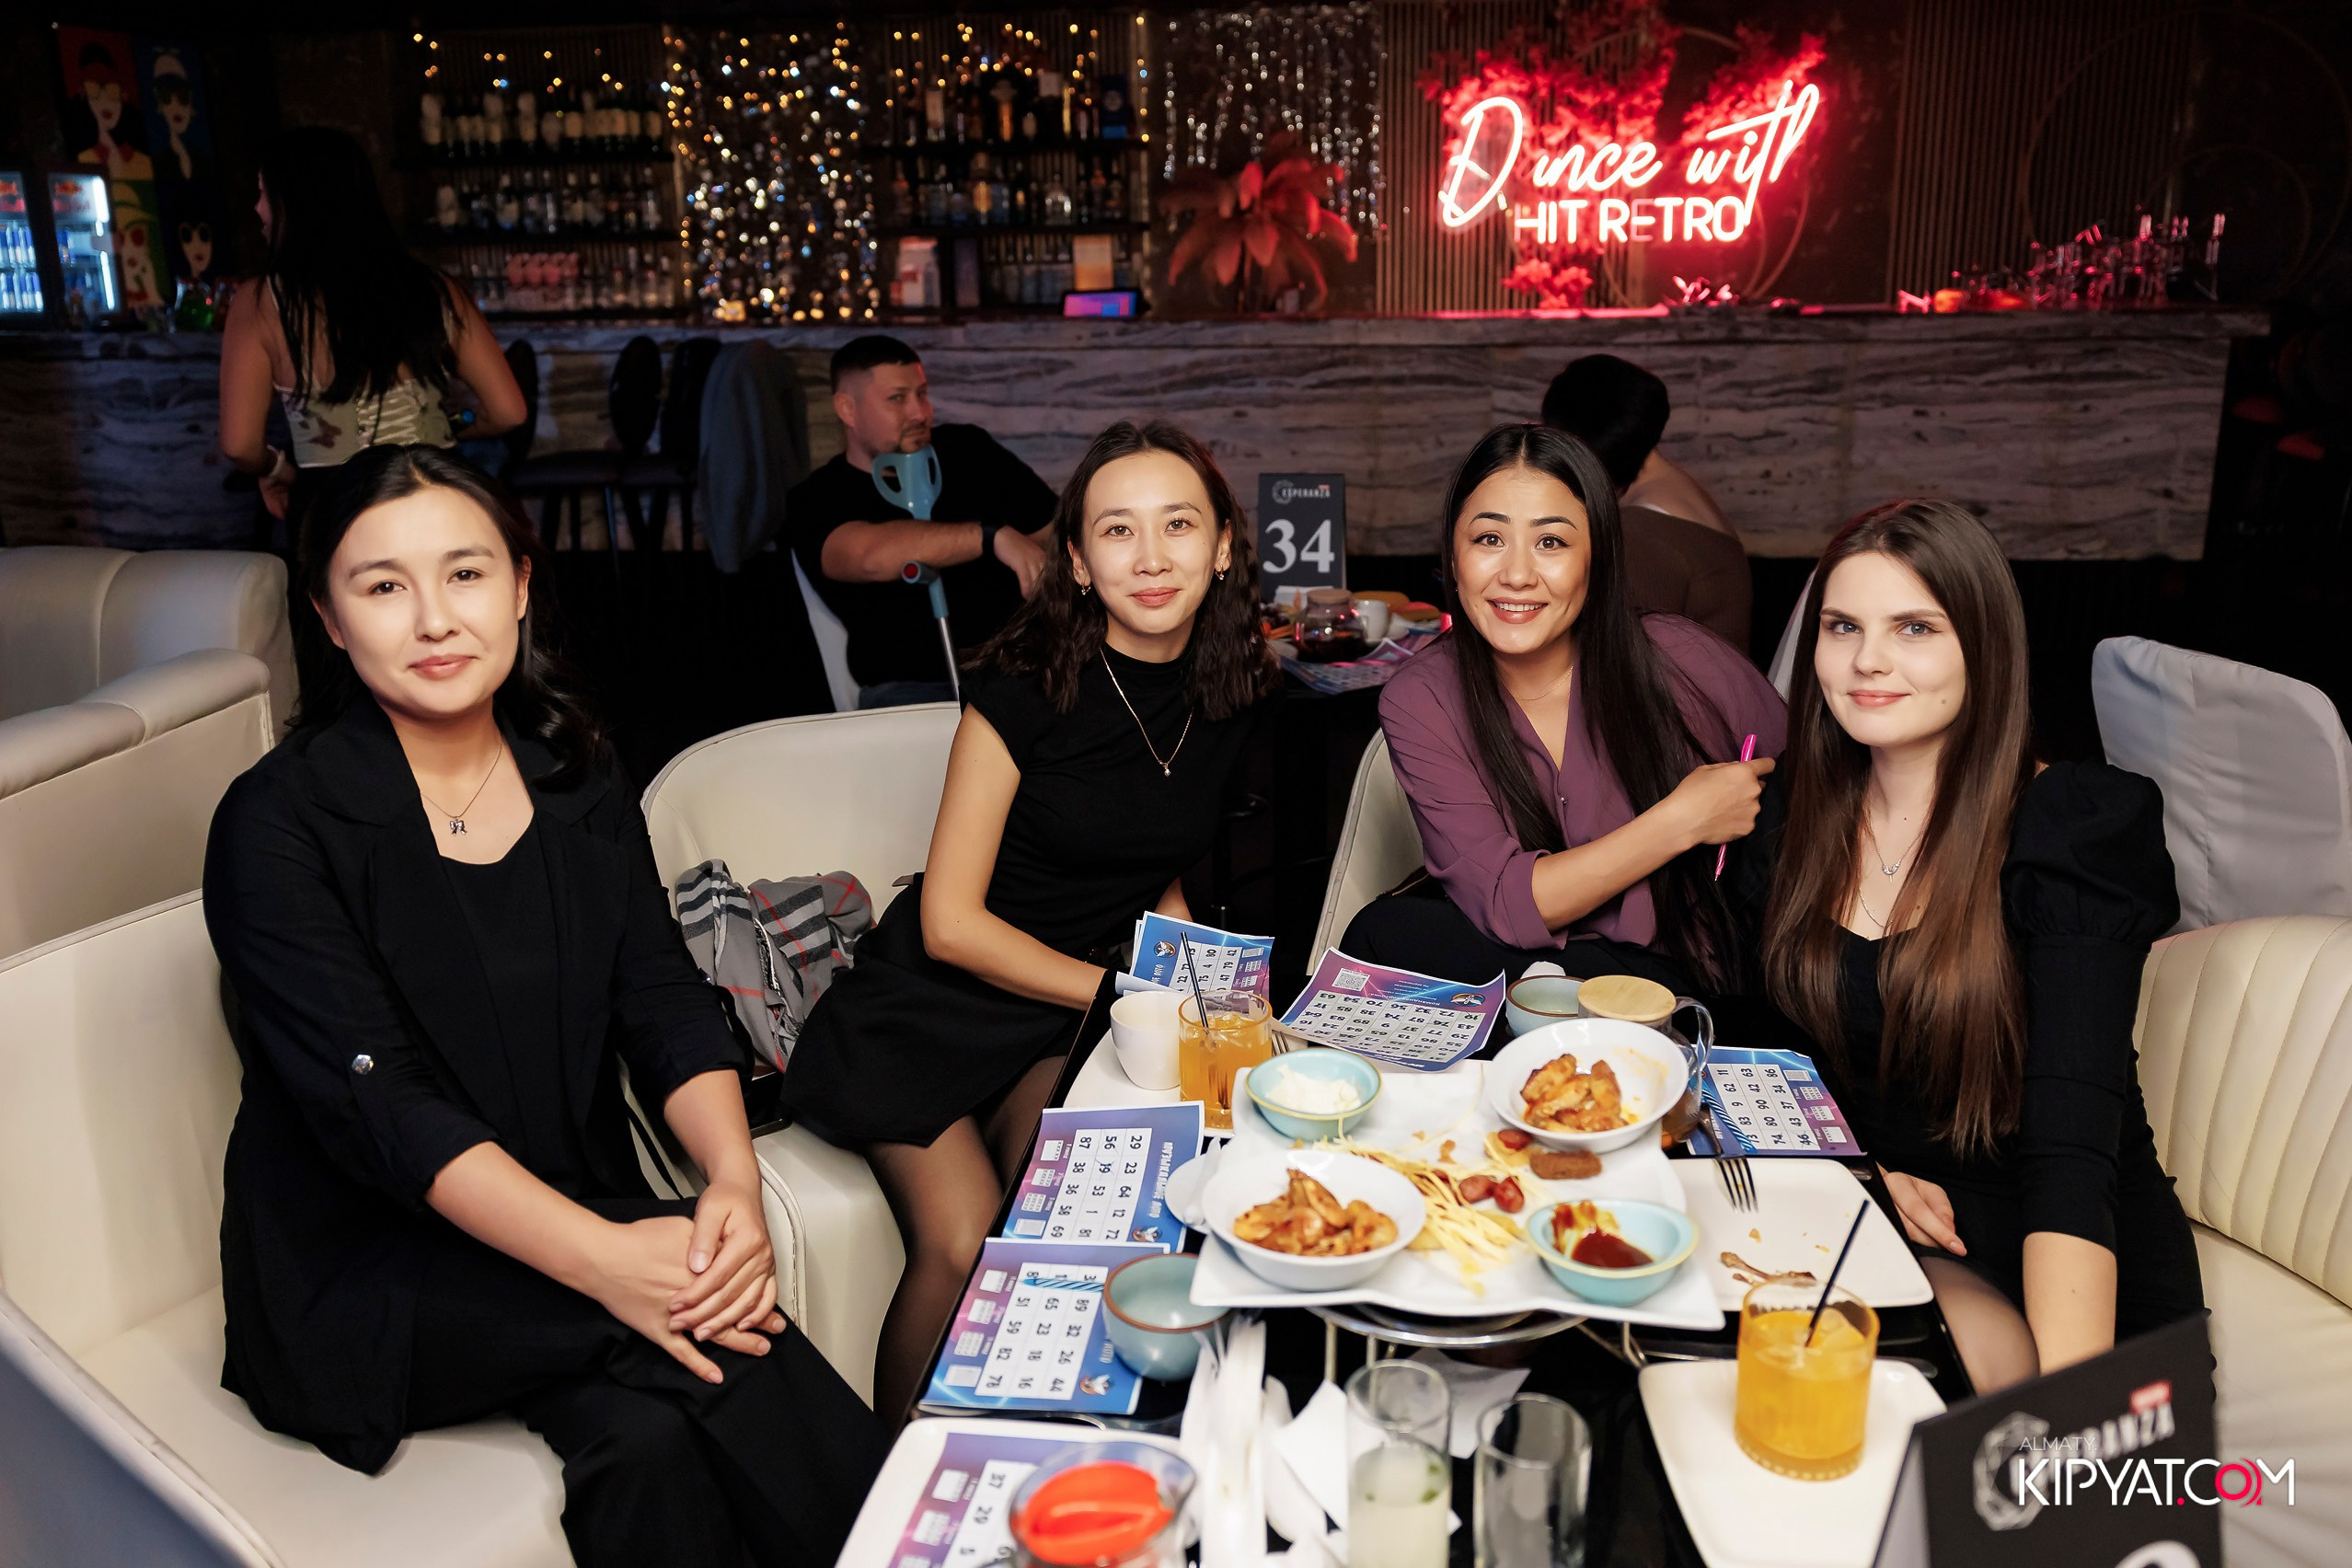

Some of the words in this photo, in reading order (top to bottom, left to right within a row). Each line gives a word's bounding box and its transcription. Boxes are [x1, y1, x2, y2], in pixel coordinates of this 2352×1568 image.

[1514, 198, 1588, 243] HIT
[1598, 195, 1745, 242] RETRO
[1262, 518, 1334, 572] 34
[1177, 975, 1189, 984] 22
[1219, 974, 1231, 983] 47
[1391, 1003, 1408, 1011] 56
[1741, 1068, 1754, 1078] 63
[1765, 1068, 1779, 1078] 86
[1724, 1084, 1737, 1092] 62
[1748, 1084, 1761, 1093] 42
[1772, 1085, 1786, 1094] 34
[1756, 1100, 1770, 1110] 90
[1781, 1101, 1794, 1110] 37
[1738, 1117, 1752, 1125] 83
[1764, 1117, 1778, 1127] 80
[1789, 1117, 1802, 1127] 43
[1079, 1136, 1092, 1149] 87
[1104, 1136, 1117, 1150] 56
[1130, 1136, 1143, 1150] 29
[1771, 1135, 1786, 1145] 74
[1797, 1134, 1811, 1146] 46
[1072, 1162, 1086, 1174] 38
[1099, 1163, 1113, 1173] 19
[1124, 1162, 1138, 1175] 23
[1066, 1184, 1079, 1195] 36
[1092, 1185, 1106, 1196] 53
[1118, 1185, 1132, 1198] 64
[1058, 1205, 1072, 1216] 58
[1112, 1209, 1126, 1218] 12
[1051, 1226, 1065, 1238] 69
[1078, 1228, 1092, 1238] 81
[1105, 1229, 1120, 1240] 72
[1016, 1297, 1031, 1308] 51
[1075, 1299, 1090, 1312] 89
[1007, 1321, 1022, 1334] 59
[1037, 1323, 1052, 1335] 23
[1066, 1325, 1082, 1337] 32
[1058, 1350, 1074, 1365] 26
[1019, 1377, 1033, 1389] 16
[1050, 1378, 1065, 1392] 44
